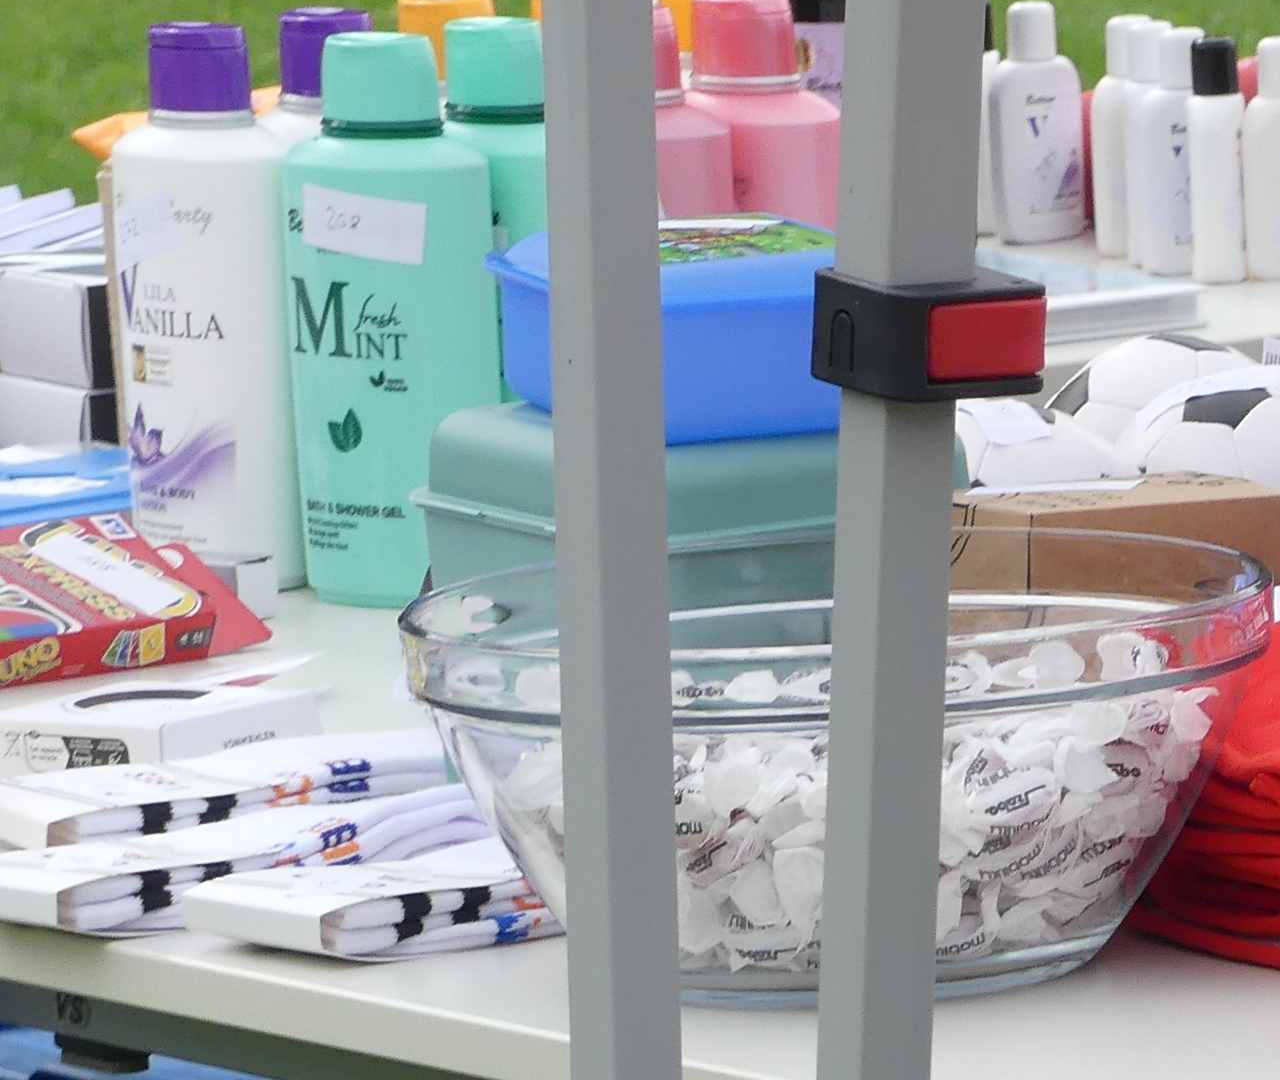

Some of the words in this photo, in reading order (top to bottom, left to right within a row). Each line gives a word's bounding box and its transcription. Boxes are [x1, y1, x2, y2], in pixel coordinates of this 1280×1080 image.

[120, 262, 225, 340] VANILLA
[144, 283, 177, 303] LILA
[353, 293, 402, 331] fresh
[291, 275, 408, 361] MINT
[381, 505, 406, 519] GEL
